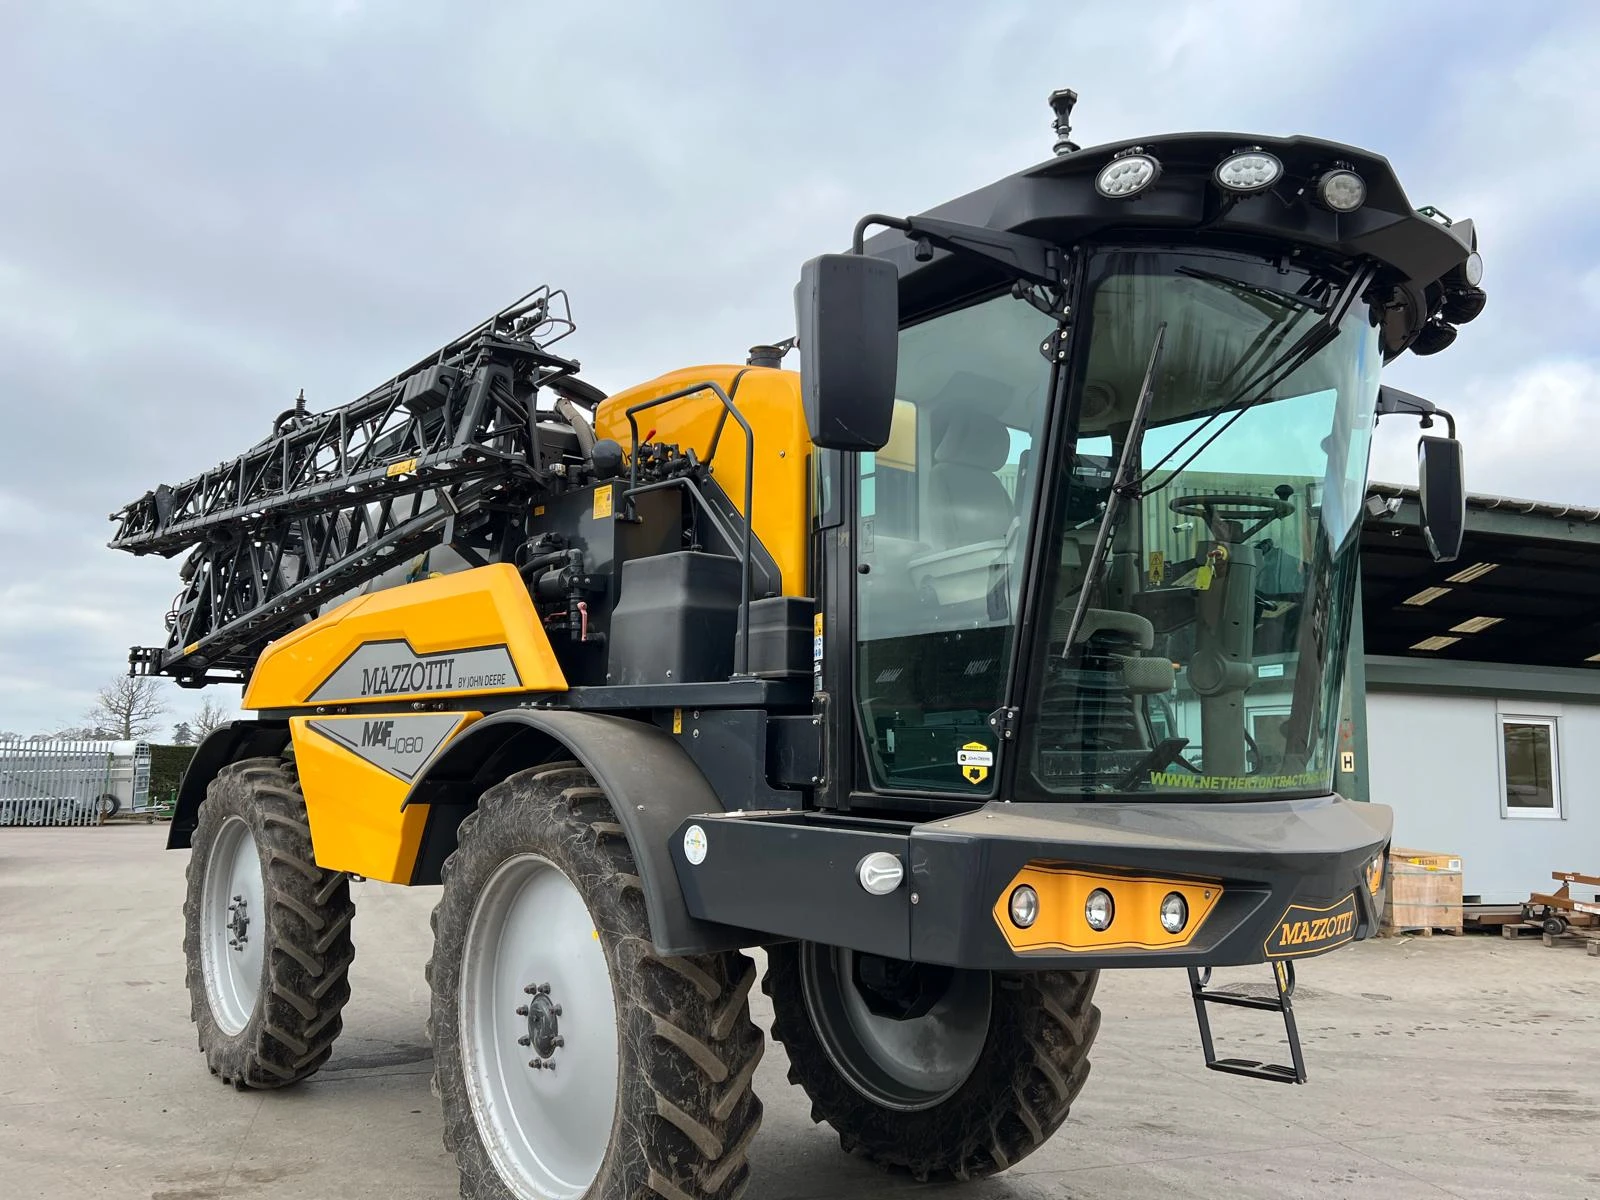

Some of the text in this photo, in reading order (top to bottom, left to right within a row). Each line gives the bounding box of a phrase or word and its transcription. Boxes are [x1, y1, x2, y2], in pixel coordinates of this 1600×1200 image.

[361, 659, 506, 696] MAZZOTTI BY JOHN DEERE
[387, 736, 424, 754] 4080
[1343, 755, 1353, 769] H
[1279, 911, 1353, 945] MAZZOTTI
